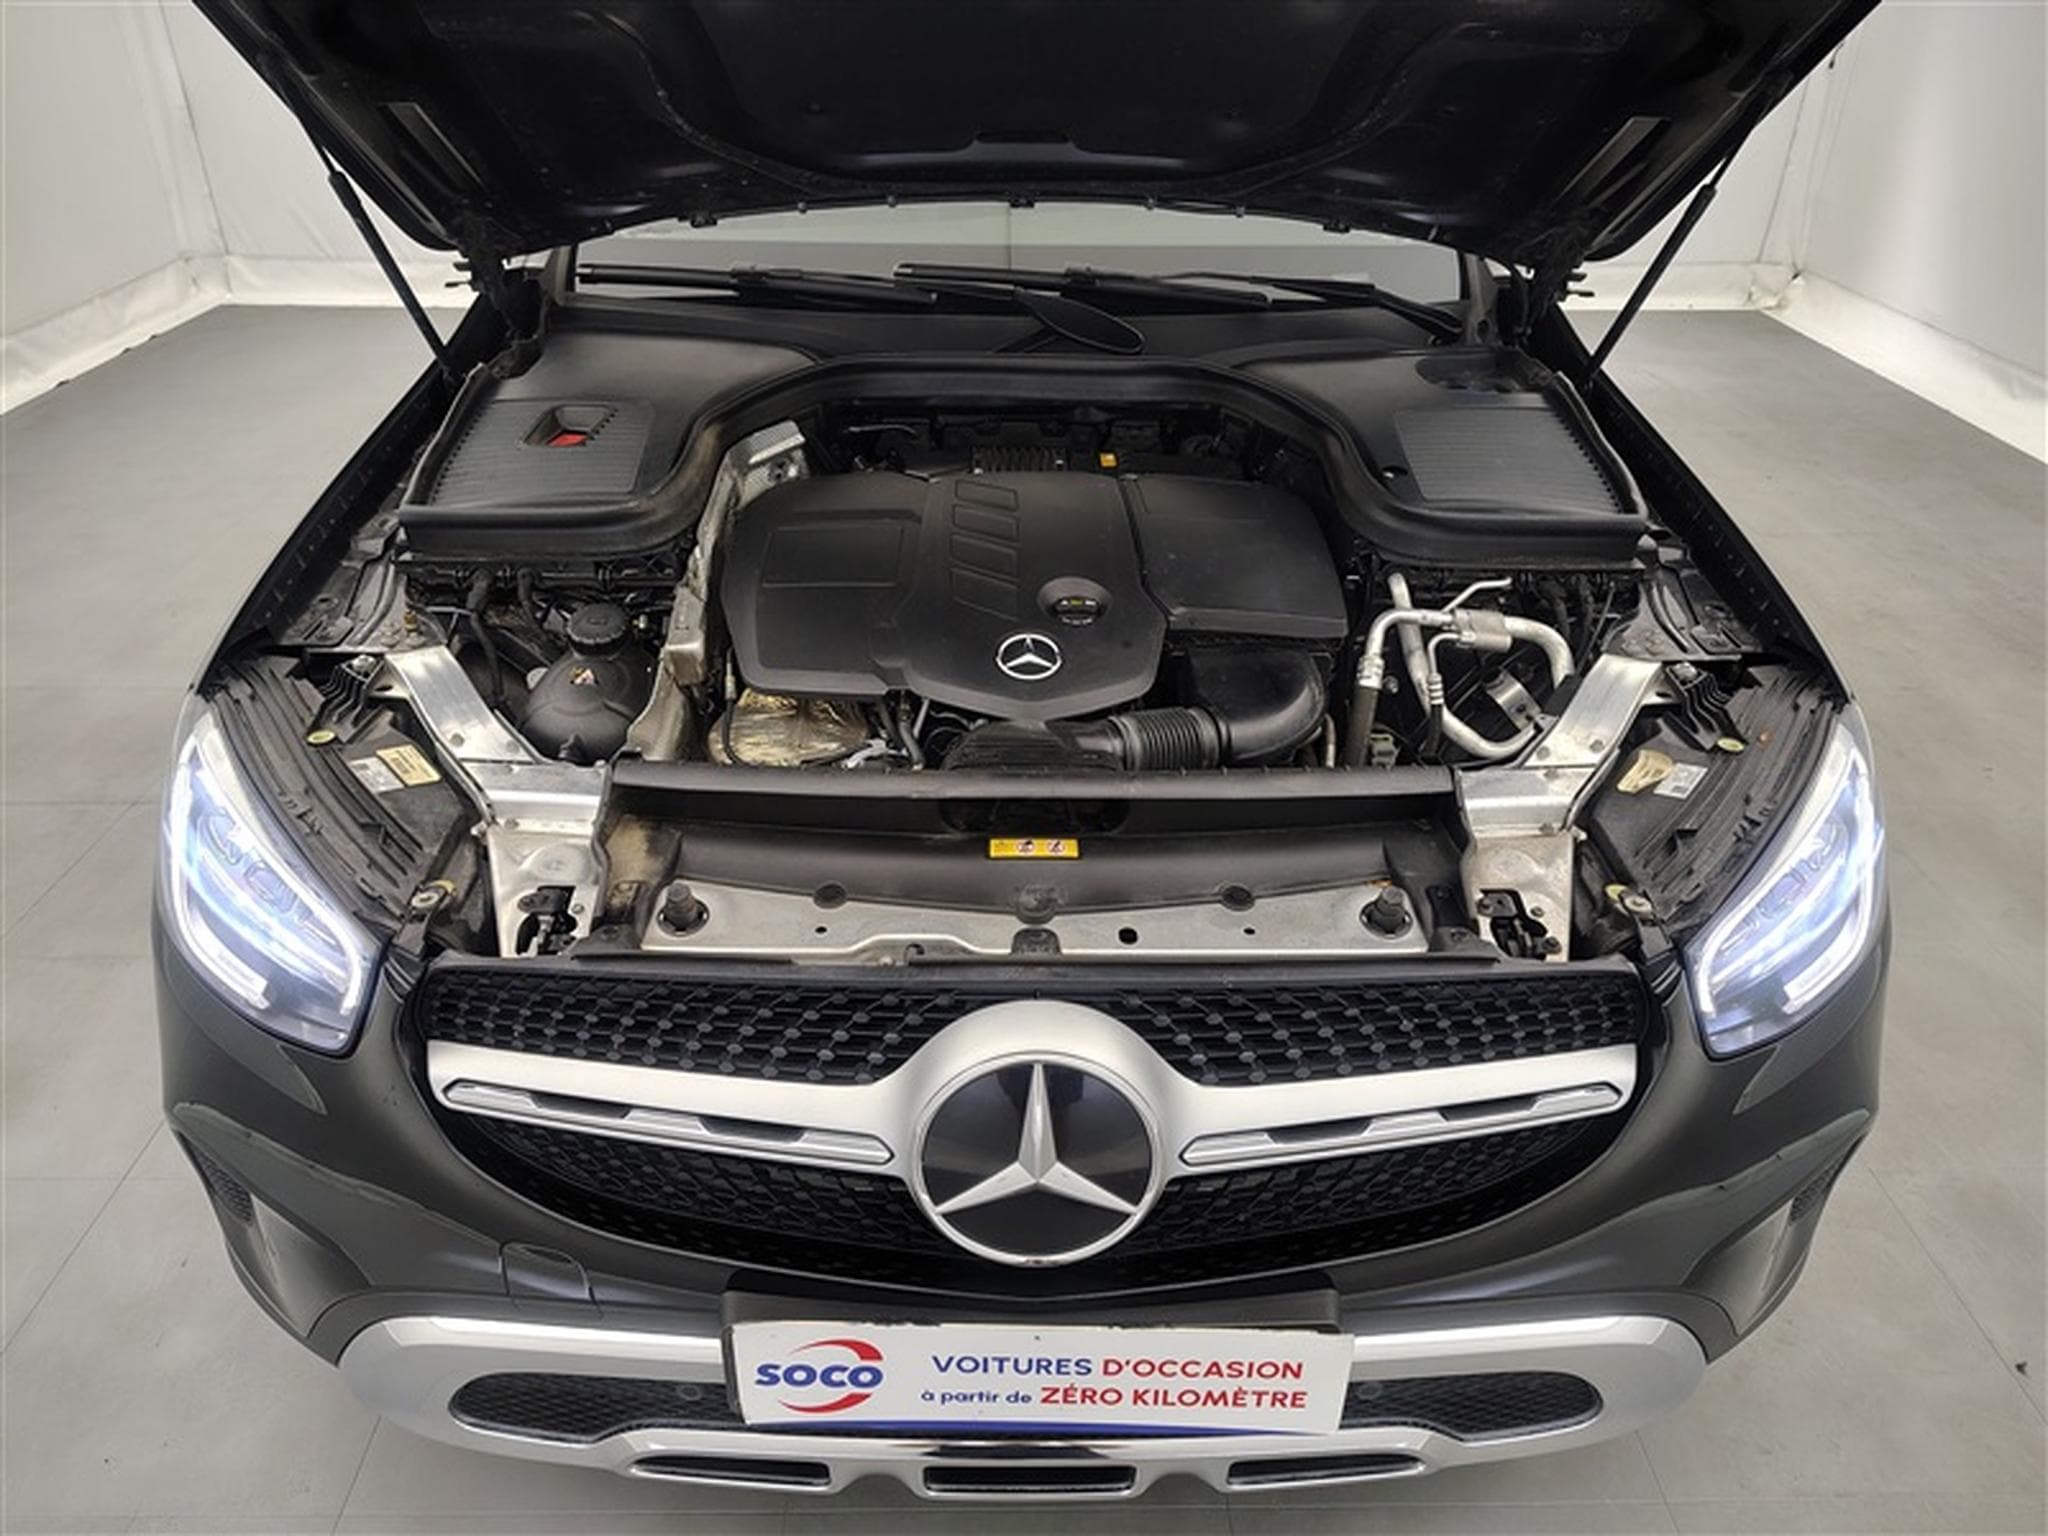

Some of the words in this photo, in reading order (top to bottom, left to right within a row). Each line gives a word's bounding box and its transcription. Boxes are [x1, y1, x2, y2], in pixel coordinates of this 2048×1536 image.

[755, 1363, 884, 1388] SOCO
[931, 1355, 1093, 1376] VOITURES
[1101, 1358, 1303, 1379] D'OCCASION
[920, 1389, 935, 1402] à
[940, 1390, 1000, 1405] partir
[1005, 1390, 1033, 1404] de
[1040, 1382, 1124, 1406] ZÉRO
[1132, 1386, 1308, 1409] KILOMÈTRE
